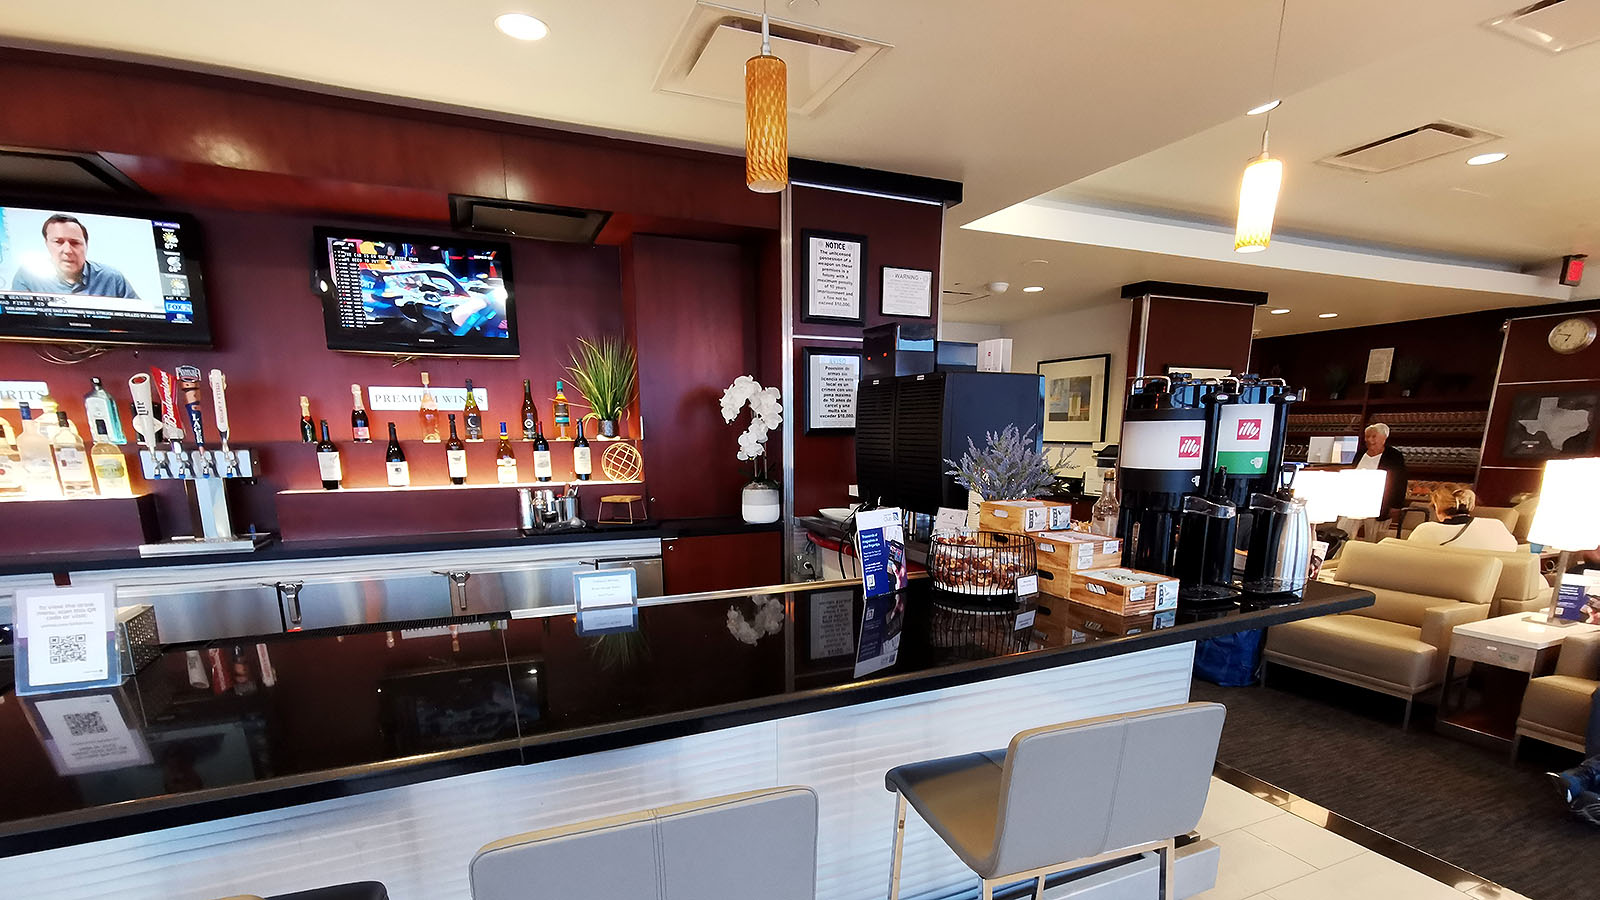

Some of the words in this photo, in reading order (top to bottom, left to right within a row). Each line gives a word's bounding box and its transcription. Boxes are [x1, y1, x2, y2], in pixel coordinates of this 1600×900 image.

[826, 242, 845, 250] NOTICE
[160, 369, 178, 428] Budweiser
[375, 394, 438, 403] PREMI
[1239, 422, 1259, 438] illy
[1180, 439, 1200, 456] illy
